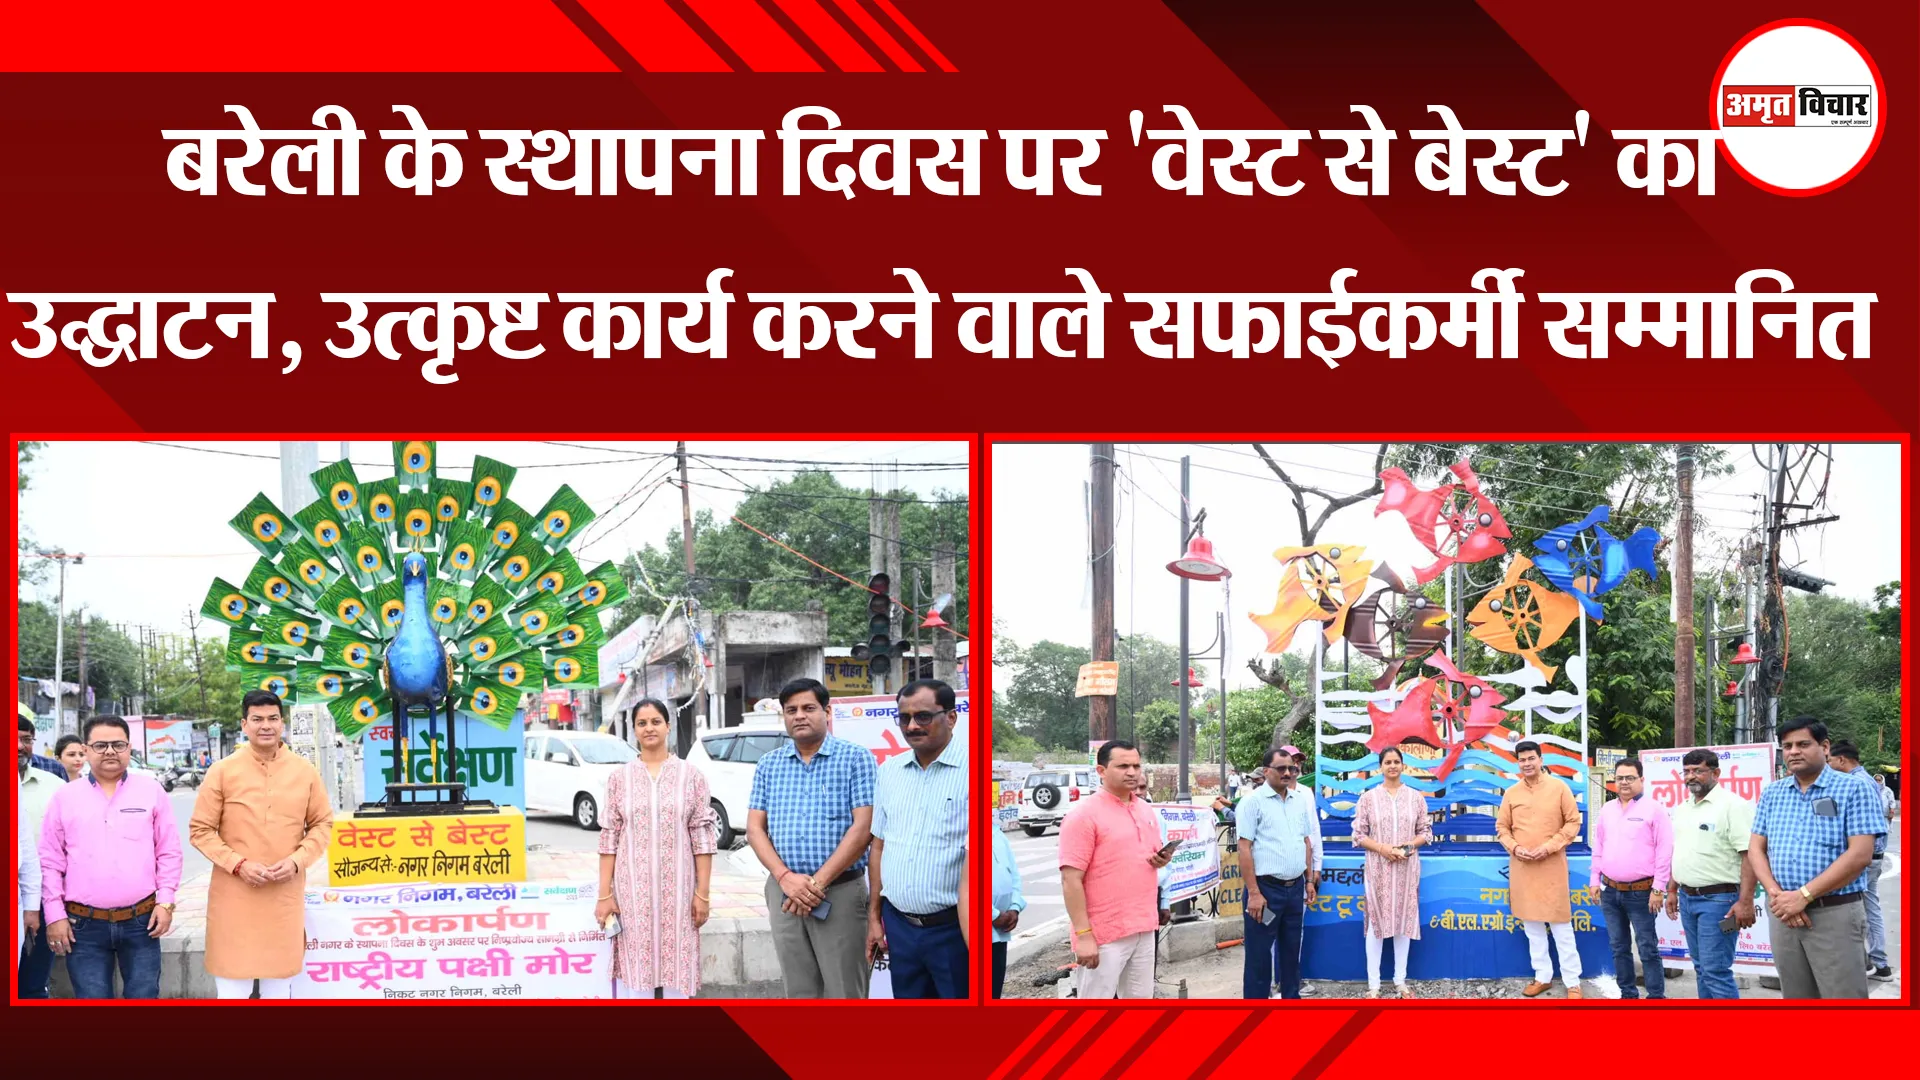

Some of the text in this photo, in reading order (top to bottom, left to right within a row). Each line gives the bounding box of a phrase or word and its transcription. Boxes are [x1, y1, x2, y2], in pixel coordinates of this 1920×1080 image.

[840, 660, 863, 678] मोहन
[380, 729, 517, 789] सर्वेक्षण
[1717, 751, 1731, 760] रेली
[337, 818, 511, 848] वेस्ट से बेस्ट
[398, 856, 429, 877] नगर
[432, 850, 470, 876] निगम
[473, 848, 511, 875] बरेली
[343, 883, 517, 904] नगर निगम, बरेली
[1221, 887, 1242, 904] CLE
[1480, 887, 1510, 905] नग
[351, 905, 550, 936] लोकार्पण
[320, 940, 342, 950] नगर
[344, 938, 354, 949] के
[356, 939, 388, 949] स्थापना
[391, 937, 414, 948] दिवस
[417, 936, 426, 947] के
[429, 938, 445, 951] शुभ
[447, 937, 475, 947] अवसर
[478, 937, 489, 946] पर
[306, 947, 597, 990] राष्ट्रीय पक्षी मोर
[383, 984, 522, 999] निकट नगर निगम, बरेली
